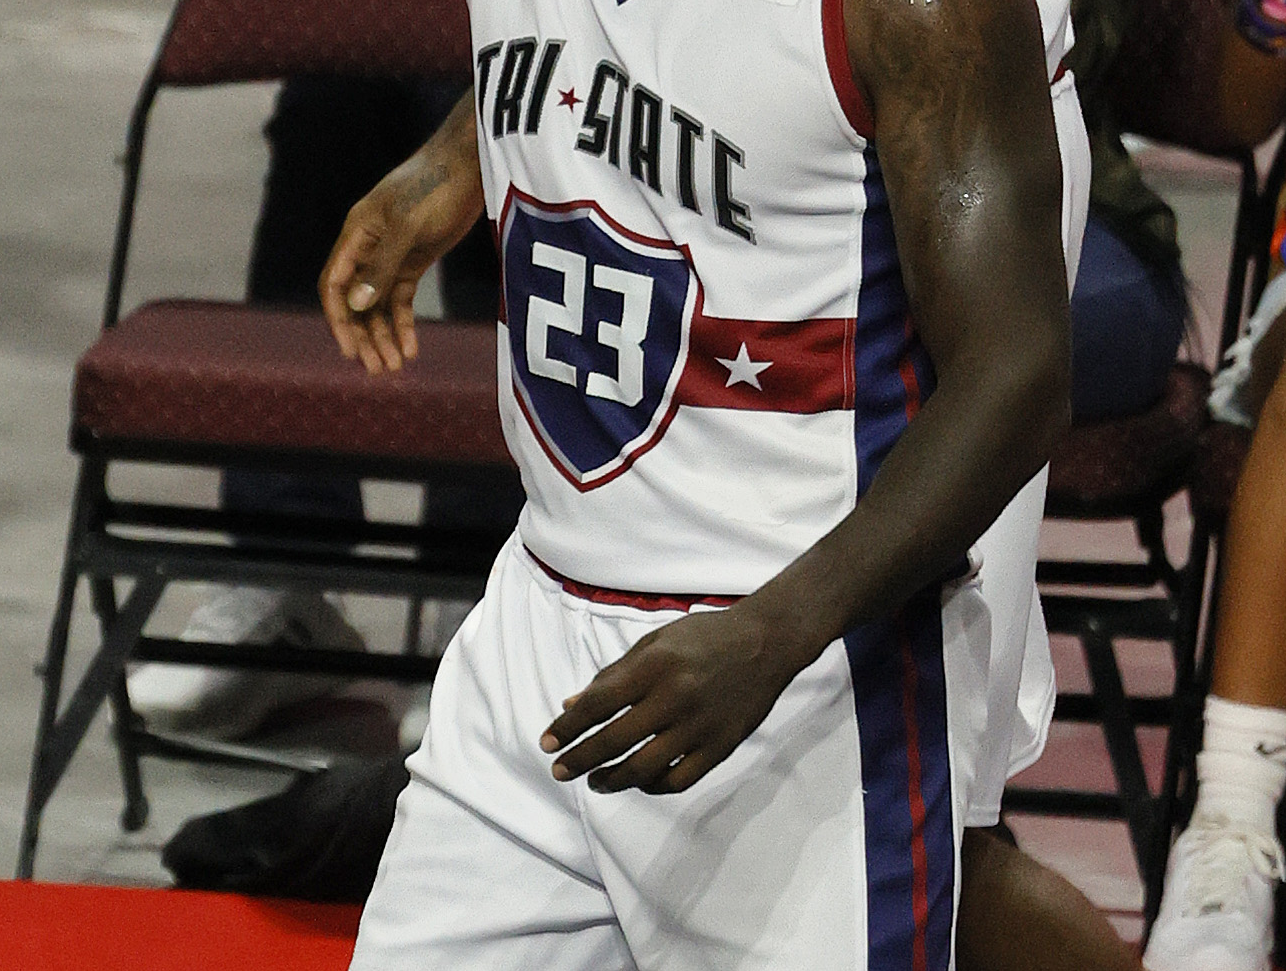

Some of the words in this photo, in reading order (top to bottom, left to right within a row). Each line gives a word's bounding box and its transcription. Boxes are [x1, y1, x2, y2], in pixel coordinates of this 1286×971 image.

[477, 36, 567, 140] TRI
[574, 58, 757, 246] STATE
[525, 241, 655, 408] 23
